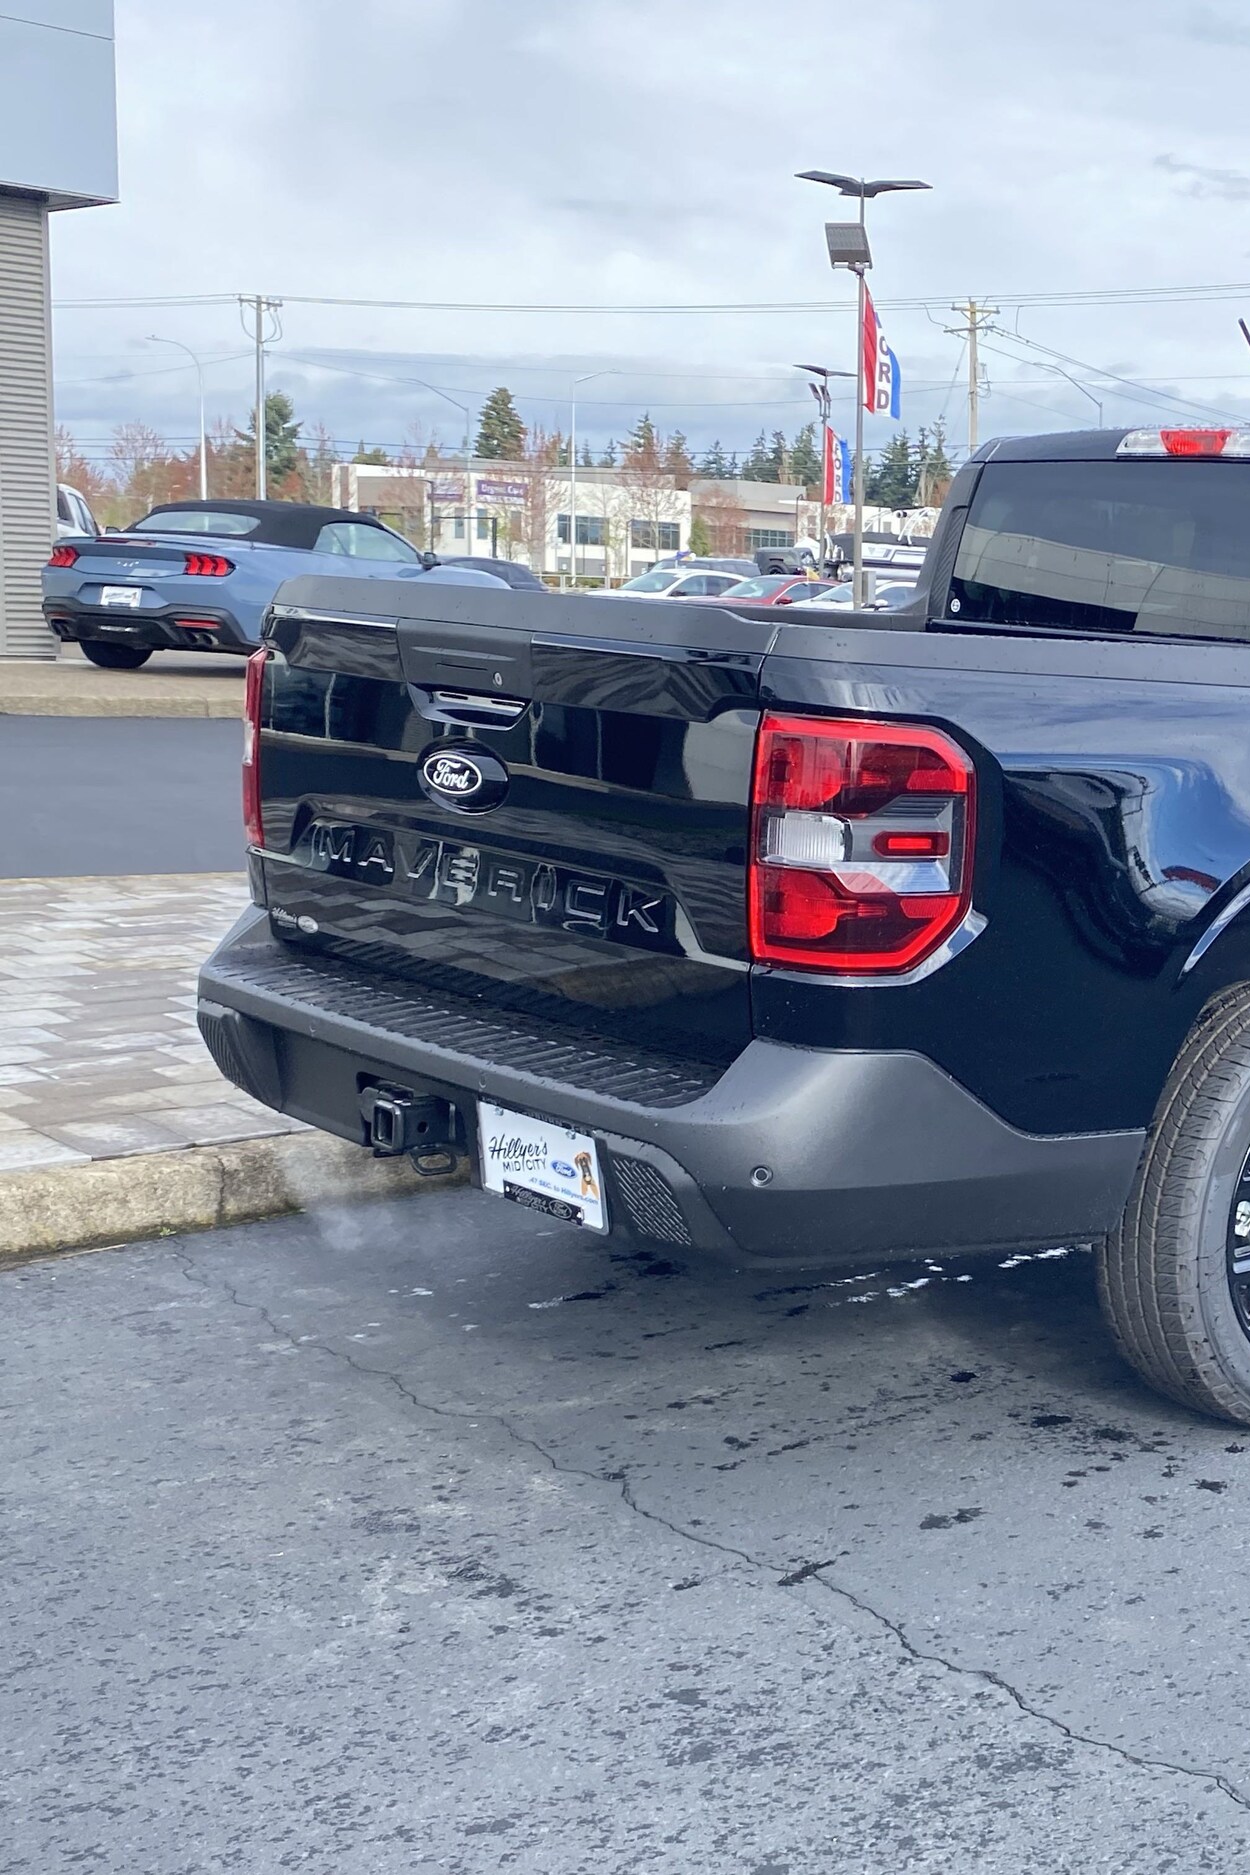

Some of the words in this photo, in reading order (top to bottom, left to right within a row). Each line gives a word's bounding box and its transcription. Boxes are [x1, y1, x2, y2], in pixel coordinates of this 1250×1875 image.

[877, 336, 891, 409] ORD
[834, 441, 843, 502] FORD
[433, 758, 470, 789] Ford
[315, 824, 662, 933] MAVERICK
[488, 1133, 548, 1172] Hillyer's
[502, 1160, 521, 1172] MID
[526, 1158, 547, 1171] CITY
